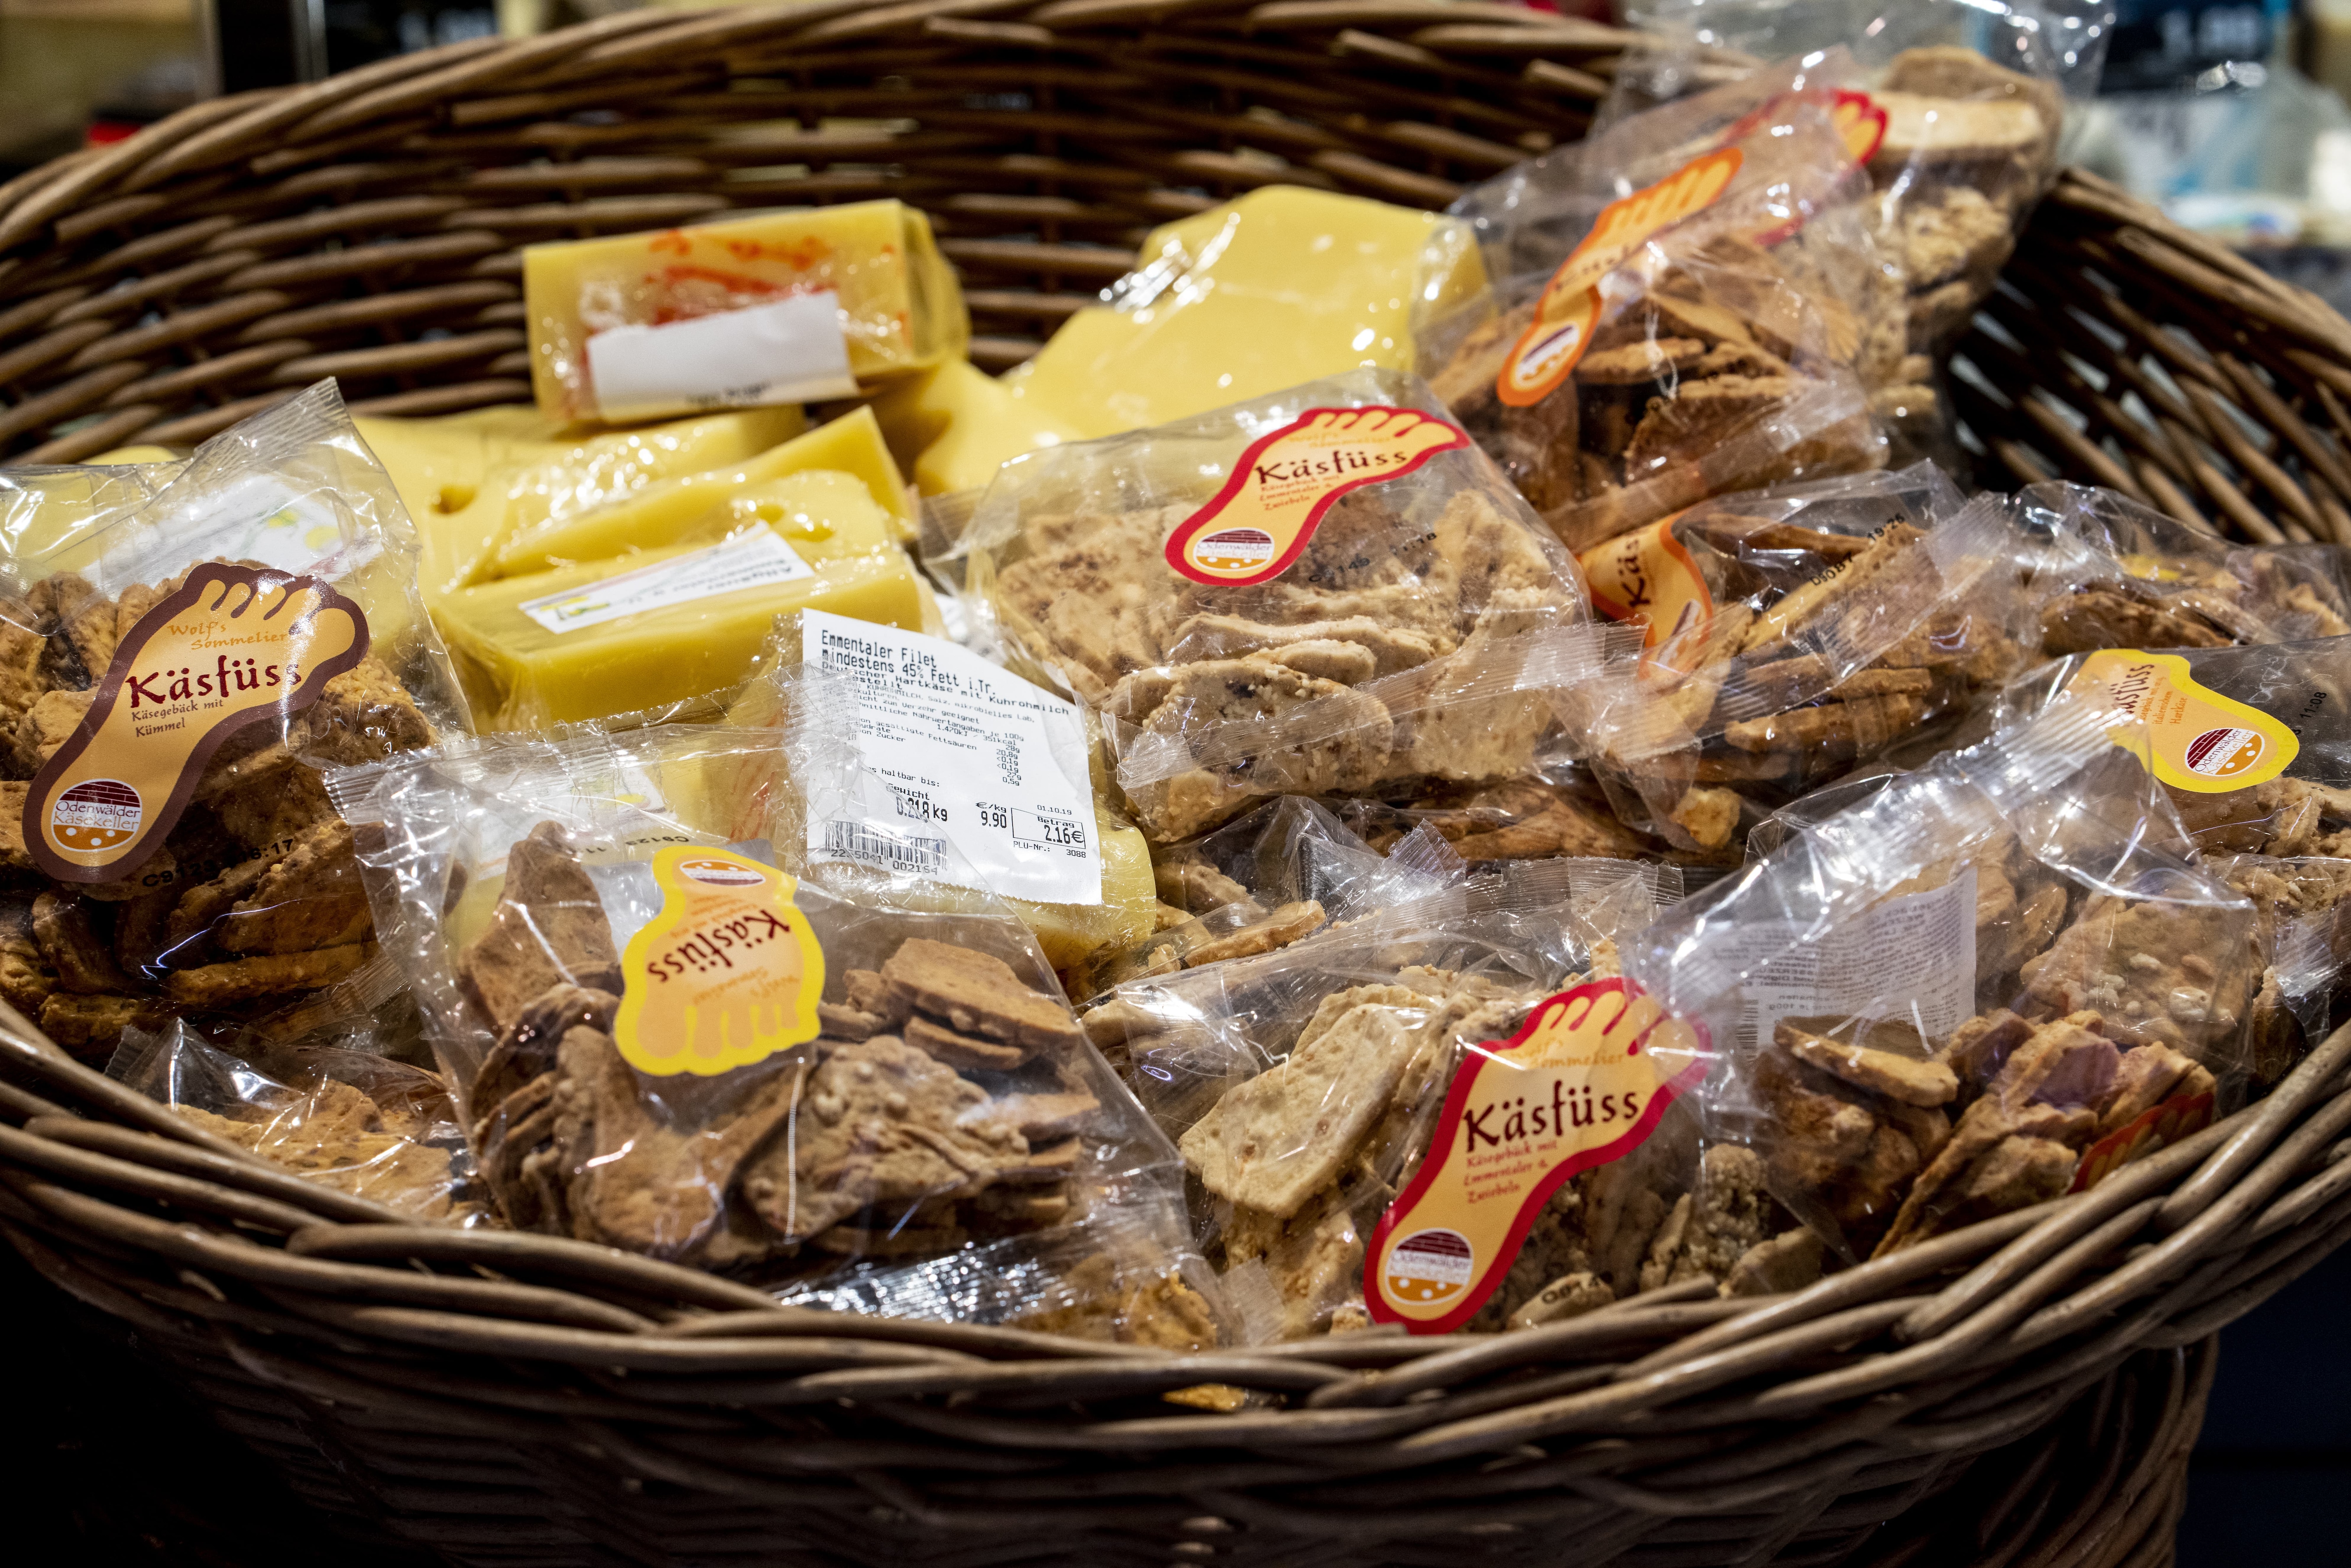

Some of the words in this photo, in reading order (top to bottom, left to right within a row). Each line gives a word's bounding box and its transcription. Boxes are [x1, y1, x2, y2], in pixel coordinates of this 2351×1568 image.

[1255, 451, 1407, 484] Käsfüss
[1868, 513, 1904, 541] 19:26
[167, 621, 226, 640] Wolf's
[191, 632, 288, 650] Sommelier
[822, 630, 893, 659] Emmentaler
[901, 647, 937, 668] Filet
[822, 648, 894, 673] mindestens
[902, 663, 924, 678] 45%
[931, 669, 959, 686] Fett
[125, 655, 302, 708] Käsfüss
[896, 676, 953, 693] Hartkäse
[961, 690, 982, 699] mit
[989, 696, 1069, 715] Kuhrohmilch
[2299, 692, 2327, 718] 11:08
[132, 700, 198, 722] Käsegebäck
[204, 699, 223, 709] mit
[902, 702, 936, 713] Verzehr
[941, 710, 979, 724] geeignet
[2170, 697, 2188, 724] Hartkäse
[135, 717, 185, 737] Kümmel
[877, 731, 906, 742] Zucker
[913, 712, 985, 734] Nährwertangaben
[1004, 733, 1024, 741] 100g
[876, 721, 924, 736] gesättigte
[929, 733, 977, 750] Fettsäuren
[996, 749, 1018, 759] 20,8g
[983, 736, 1016, 745] 351kcal
[1006, 744, 1020, 753] 28g
[2195, 729, 2242, 772] Odenwälder
[2203, 731, 2254, 775] Käsekeller
[882, 768, 916, 781] haltbar
[921, 777, 940, 787] bis:
[1002, 777, 1019, 786] 0,5g
[1007, 772, 1021, 780] 27g
[886, 783, 930, 800] Gewicht
[56, 801, 140, 817] Odenwälder
[981, 811, 1007, 828] 9.90
[1037, 805, 1072, 815] 01.10.19
[53, 811, 139, 829] Käsekeller
[1037, 816, 1075, 828] Betrag
[1044, 825, 1085, 844] 2.16€
[239, 839, 293, 863] 16:17
[1013, 841, 1050, 852] PLU-Nr.:
[1066, 849, 1086, 858] 3088
[647, 909, 791, 983] Käsfüss
[1462, 1079, 1639, 1153] Käsfüss
